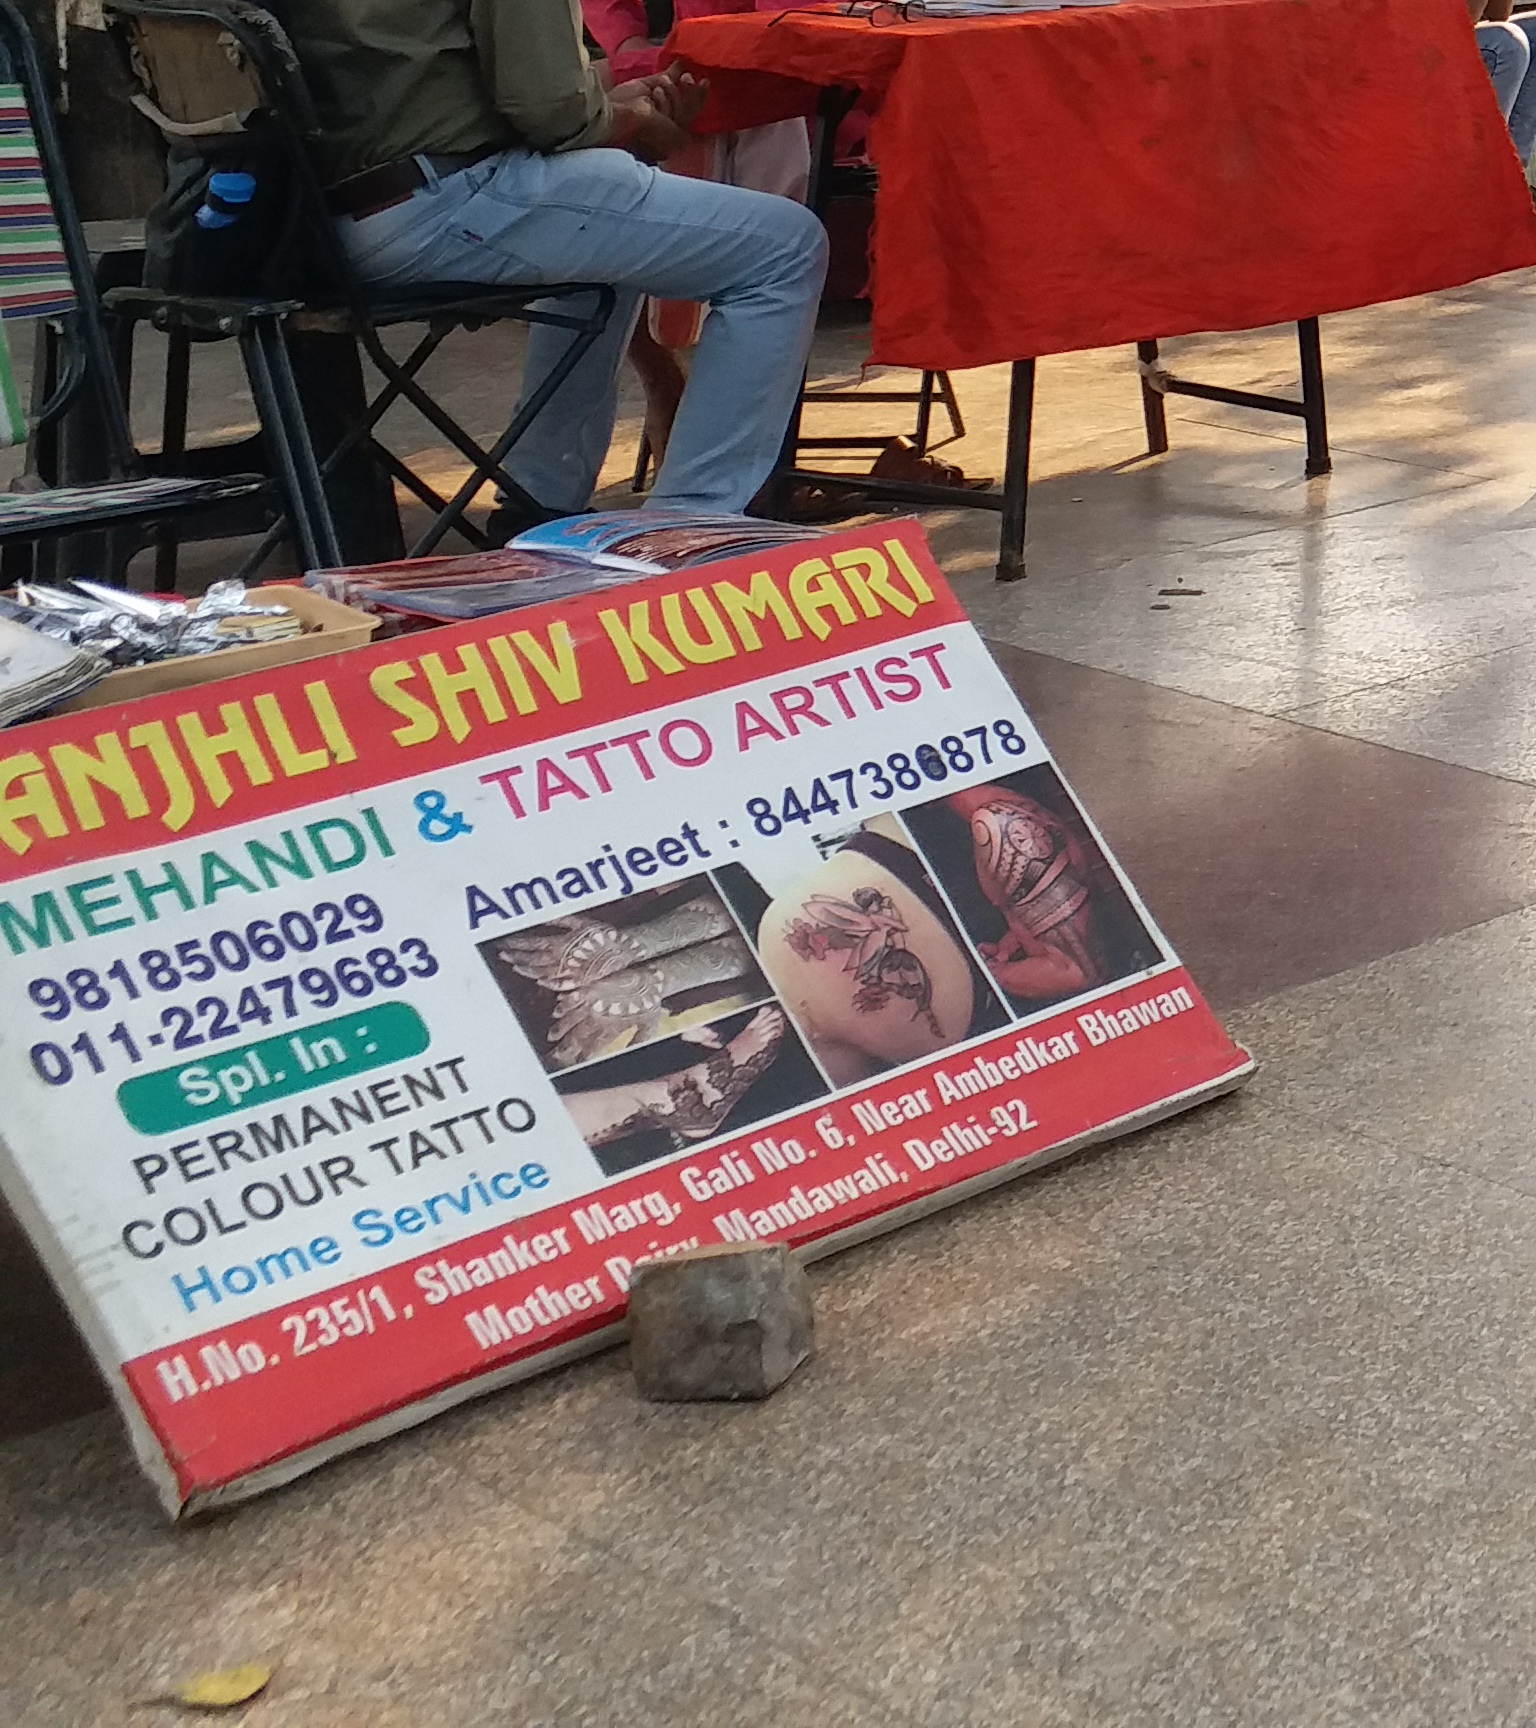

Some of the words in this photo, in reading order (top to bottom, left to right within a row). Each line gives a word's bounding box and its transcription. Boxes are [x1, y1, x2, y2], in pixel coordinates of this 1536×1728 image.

[0, 680, 358, 856] ANJHLI
[369, 621, 584, 749] SHIV
[598, 538, 935, 685] KUMARI
[1, 806, 396, 956] MEHANDI
[412, 788, 475, 844] &
[479, 717, 713, 821] TATTO
[734, 642, 954, 753] ARTIST
[464, 822, 712, 931] Amarjeet
[27, 892, 385, 1022] 9818506029
[28, 936, 440, 1087] 011-22479683
[131, 1055, 473, 1197] PERMANENT
[178, 1050, 287, 1110] Spl.
[299, 1033, 348, 1076] In
[121, 1154, 369, 1260] COLOUR
[369, 1096, 538, 1177] TATTO
[155, 1339, 280, 1403] H.No.
[413, 1223, 573, 1306] Shanker
[570, 1186, 682, 1247] Marg,
[679, 1153, 756, 1203] Gali
[750, 1132, 818, 1178] No.
[815, 1113, 857, 1150] 6,
[850, 1088, 935, 1136] Near
[933, 1034, 1080, 1106] Ambedkar
[1076, 984, 1196, 1048] Bhawan
[171, 1234, 345, 1314] Home
[351, 1159, 552, 1248] Service
[463, 1273, 605, 1351] Mother
[712, 1153, 910, 1245] Mandawali,
[901, 1098, 1038, 1175] Delhi-92
